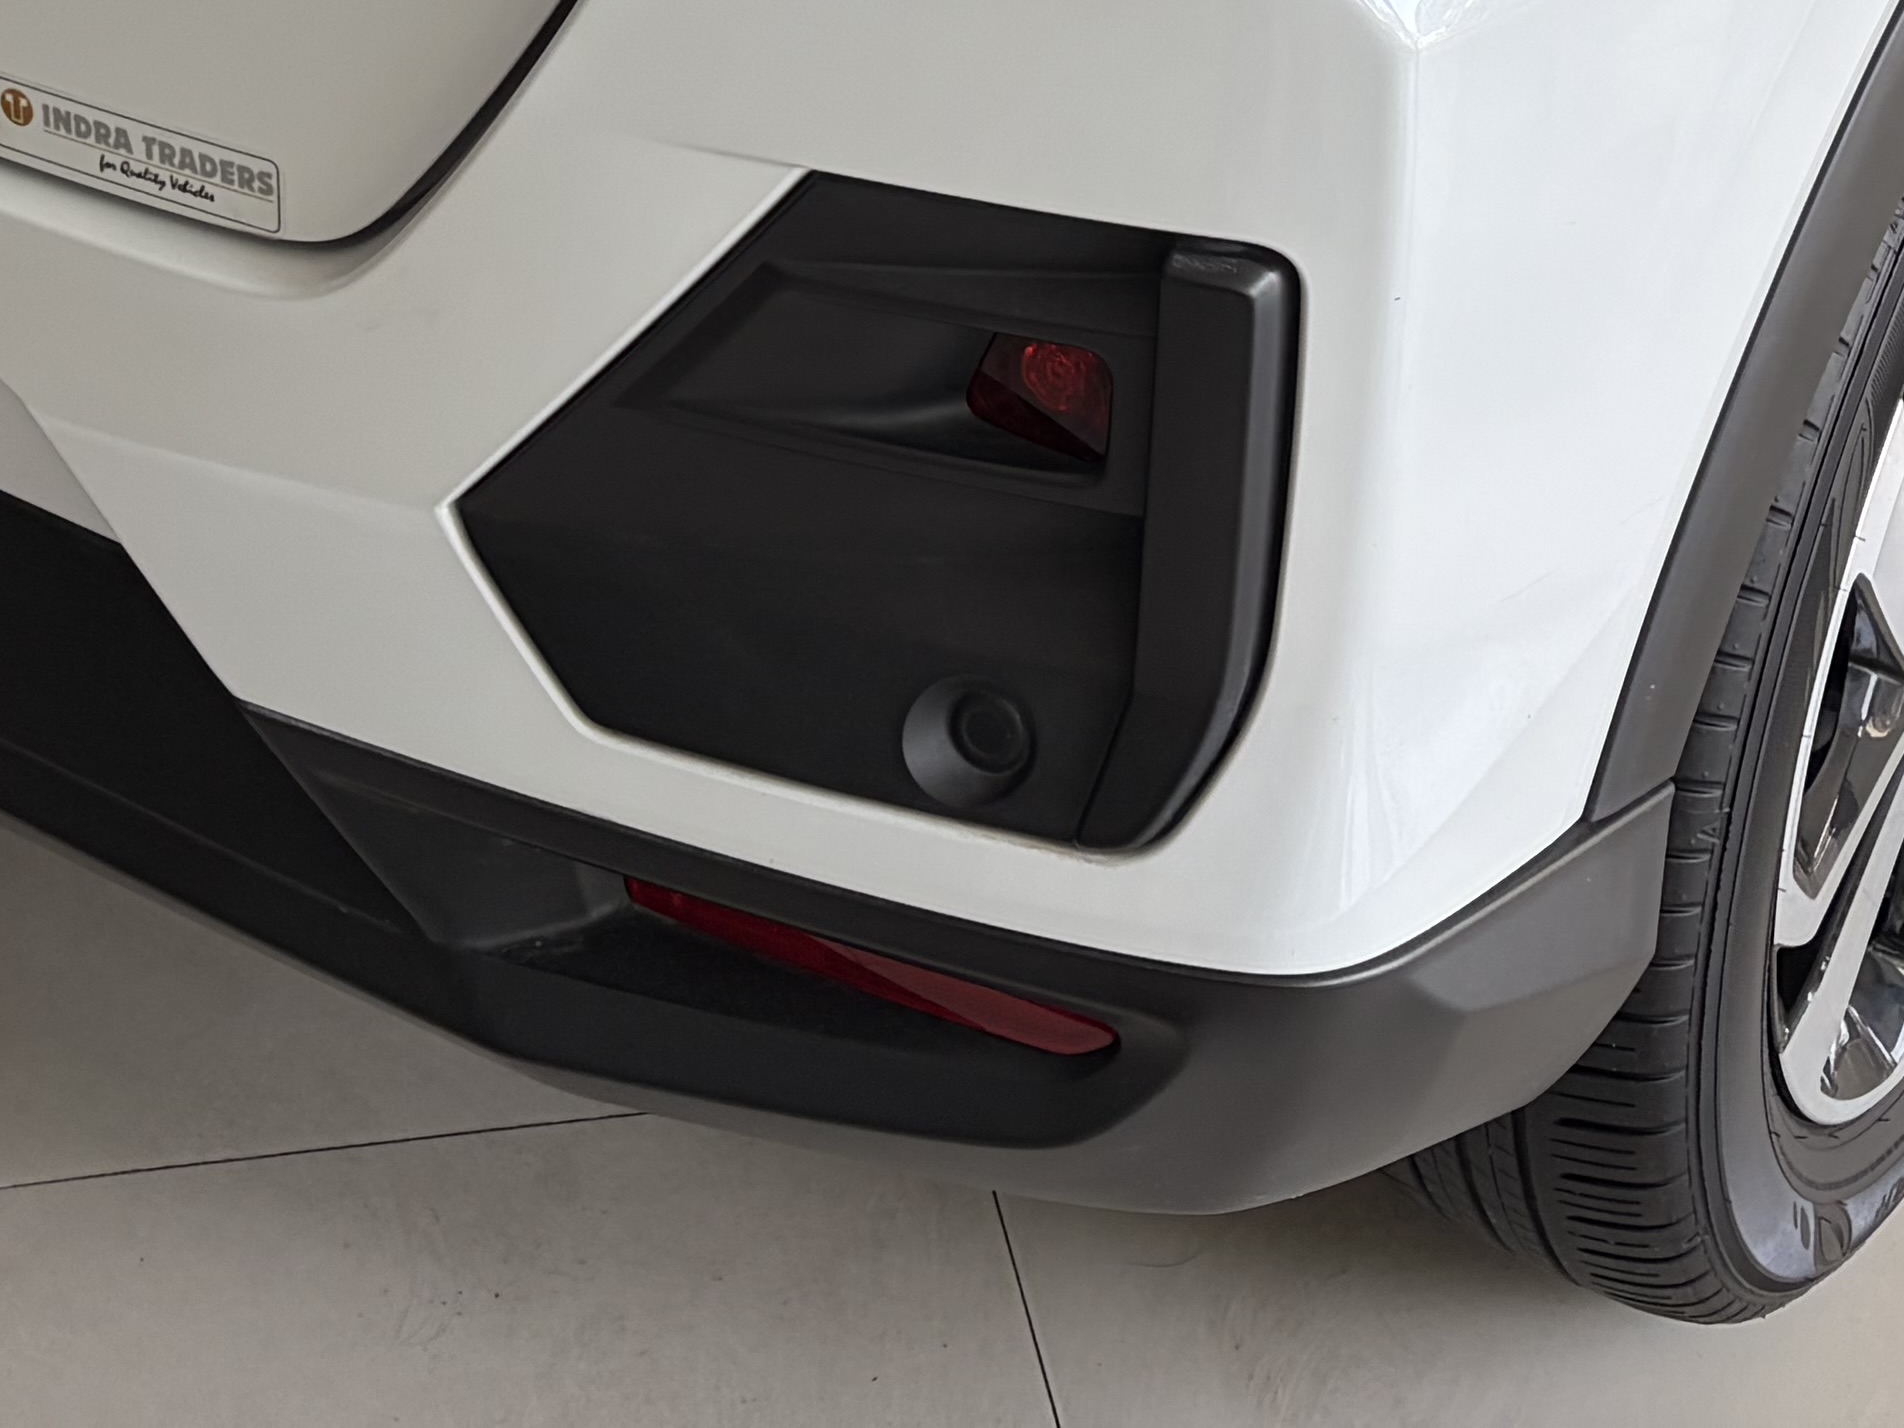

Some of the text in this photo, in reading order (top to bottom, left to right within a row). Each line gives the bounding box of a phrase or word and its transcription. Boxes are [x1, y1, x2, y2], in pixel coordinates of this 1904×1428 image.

[41, 103, 275, 196] INDRA TRADERS
[120, 161, 166, 191] Quality
[170, 175, 215, 202] Vehicles
